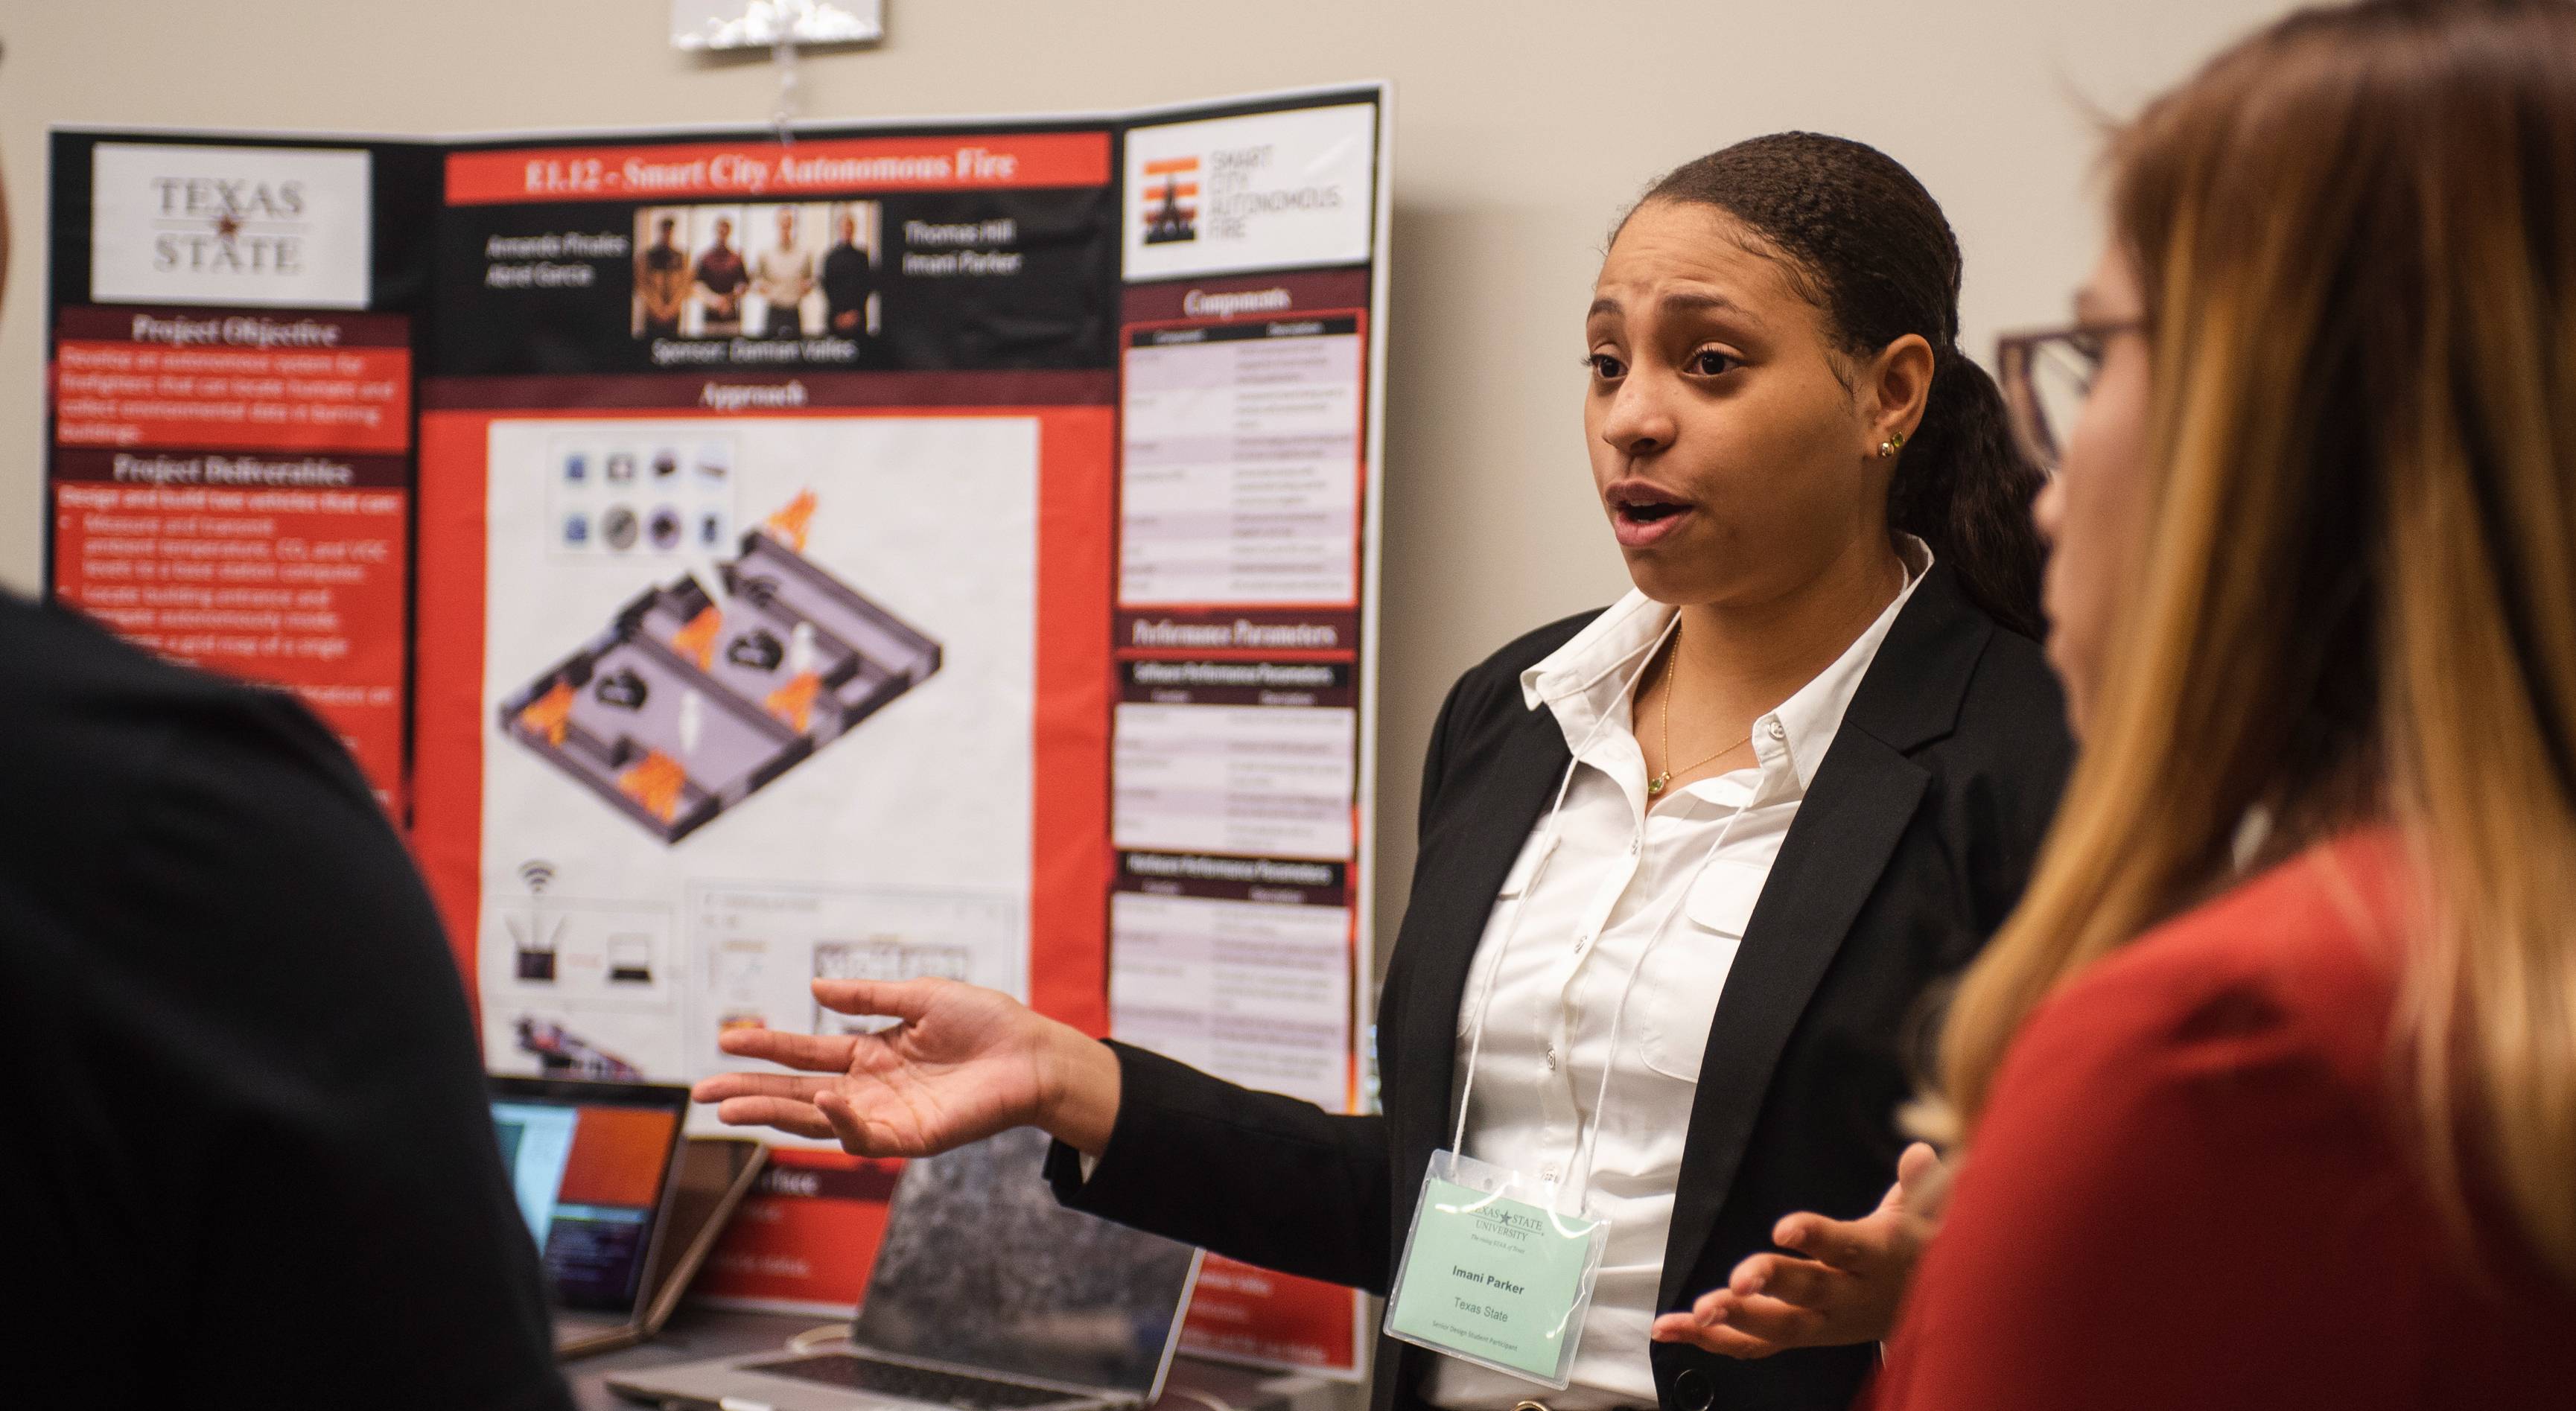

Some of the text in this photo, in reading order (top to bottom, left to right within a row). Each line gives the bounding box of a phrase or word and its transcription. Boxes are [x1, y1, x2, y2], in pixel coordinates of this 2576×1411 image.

[525, 157, 600, 192] E1.12
[624, 156, 705, 190] Smart
[709, 153, 775, 193] City
[778, 151, 952, 186] Autonomous
[956, 147, 1020, 180] Fire
[1209, 145, 1273, 171] SMART
[153, 176, 305, 217] TEXAS
[1209, 186, 1343, 217] AUTONOMOUS
[905, 217, 1016, 245] Thomas Hill
[1209, 217, 1247, 240] FIRE
[153, 235, 302, 275] STATE
[903, 250, 1023, 275] Imani Parker
[534, 261, 594, 287] Garcia
[1184, 289, 1292, 319] Components
[133, 315, 340, 346] Project Objective
[651, 336, 859, 366] Sponsor: Damian Valles
[699, 378, 808, 411] Approach
[114, 454, 353, 486] Project Deliverables
[1133, 619, 1338, 647] Performance Parameters
[1475, 1219, 1528, 1241] UNIVERSITY
[1512, 1214, 1543, 1231] STATE
[1452, 1265, 1525, 1295] Imani Parker
[1454, 1296, 1508, 1322] Texas State
[1432, 1320, 1518, 1352] Senior Design Student Participant
